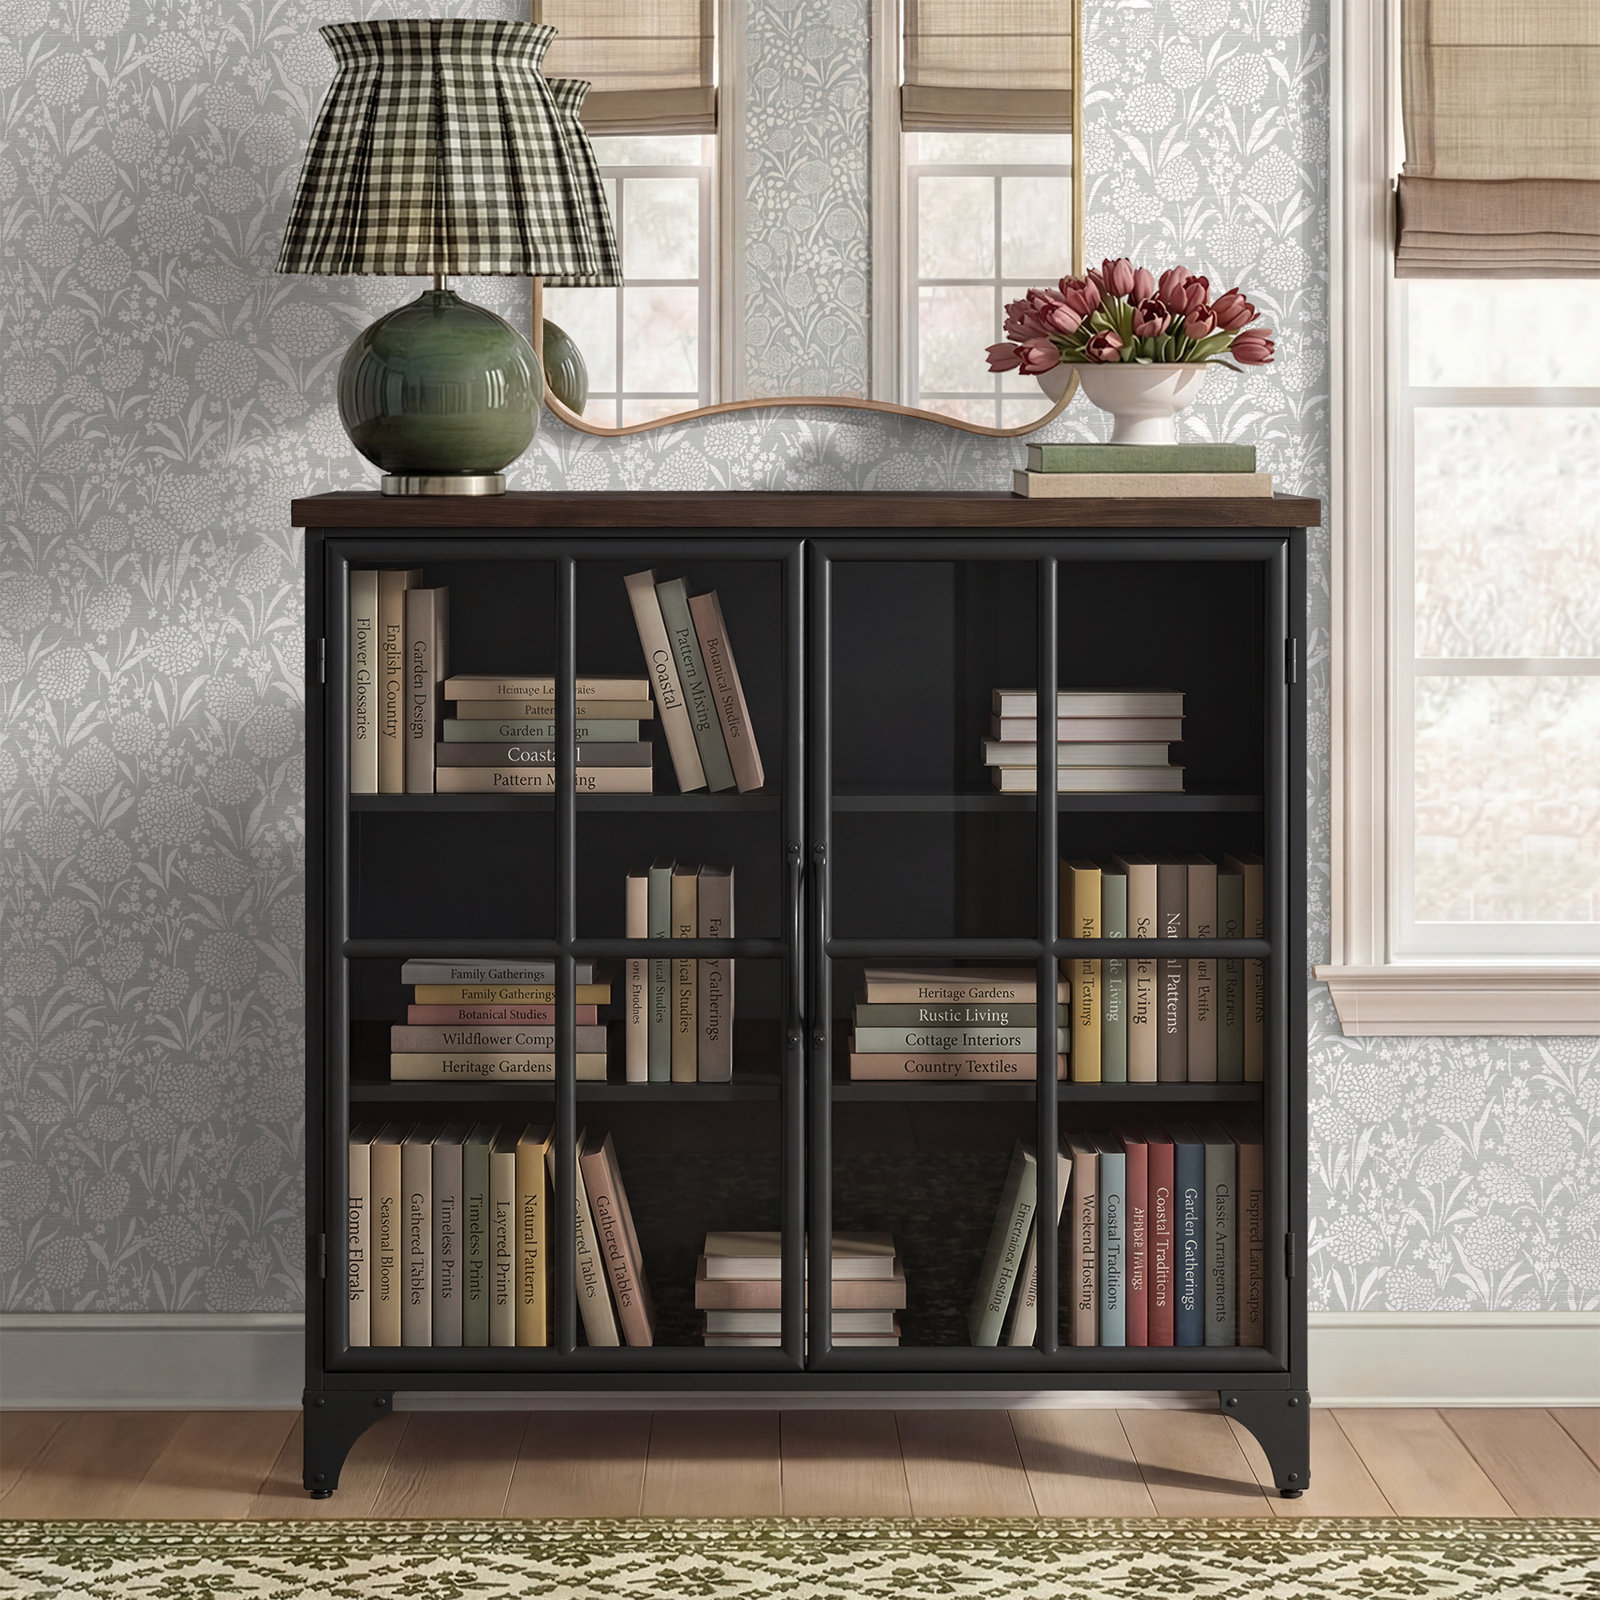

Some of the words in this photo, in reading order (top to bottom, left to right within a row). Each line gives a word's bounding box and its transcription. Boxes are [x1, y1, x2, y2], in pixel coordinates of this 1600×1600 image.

[356, 618, 371, 666] Flower
[382, 624, 402, 675] English
[413, 640, 428, 689] Garden
[652, 649, 683, 710] Coastal
[675, 627, 698, 679] Pattern
[689, 681, 712, 732] Mixing
[706, 637, 731, 694] Botanical
[721, 695, 741, 738] Studies
[356, 669, 371, 740] Glossaries
[382, 680, 401, 739] Country
[410, 694, 428, 740] Design
[499, 725, 544, 737] Garden
[493, 773, 542, 786] Pattern
[546, 774, 596, 790] Ming
[450, 968, 487, 982] Family
[488, 969, 546, 982] Gatherings
[461, 989, 497, 1002] Family
[499, 989, 556, 1003] Gatherings
[918, 987, 966, 1001] Heritage
[968, 987, 1015, 999] Gardens
[458, 1009, 507, 1020] Botanical
[509, 1009, 547, 1020] Studies
[656, 986, 669, 1024] Studies
[679, 988, 693, 1034] Studies
[705, 973, 723, 1041] Gatherings
[919, 1009, 962, 1022] Rustic
[965, 1009, 1009, 1026] Living
[1106, 978, 1122, 1022] Living
[1132, 978, 1151, 1025] Living
[1166, 974, 1181, 1034] Patterns
[442, 1032, 513, 1045] Wildflower
[905, 1033, 959, 1050] Cottage
[962, 1033, 1022, 1046] Interiors
[441, 1060, 496, 1076] Heritage
[499, 1060, 552, 1074] Gardens
[904, 1060, 962, 1077] Country
[966, 1060, 1018, 1073] Textiles
[349, 1196, 364, 1244] Home
[380, 1196, 394, 1252] Seasonal
[410, 1193, 425, 1255] Gathered
[441, 1195, 456, 1255] Timeless
[469, 1193, 484, 1256] Timeless
[493, 1201, 511, 1258] Layered
[524, 1194, 538, 1246] Natural
[1082, 1194, 1095, 1254] Weekend
[1107, 1194, 1121, 1242] Coastal
[1156, 1187, 1170, 1236] Coastal
[1184, 1188, 1199, 1237] Garden
[1215, 1183, 1230, 1229] Classic
[1245, 1189, 1264, 1245] Inspired
[349, 1249, 364, 1301] Florals
[596, 1195, 625, 1261] Gathered
[613, 1262, 633, 1308] Tables
[1156, 1238, 1170, 1307] Traditions
[1181, 1239, 1199, 1311] Gatherings
[380, 1256, 394, 1301] Blooms
[441, 1260, 455, 1299] Prints
[469, 1260, 484, 1300] Prints
[496, 1262, 511, 1306] Prints
[524, 1250, 538, 1305] Patterns
[580, 1257, 598, 1299] Tables
[988, 1266, 1014, 1313] Hosting
[1079, 1259, 1095, 1311] Hosting
[1107, 1244, 1121, 1311] Traditions
[1212, 1230, 1230, 1323] Arrangements
[1245, 1247, 1264, 1324] Landscapes
